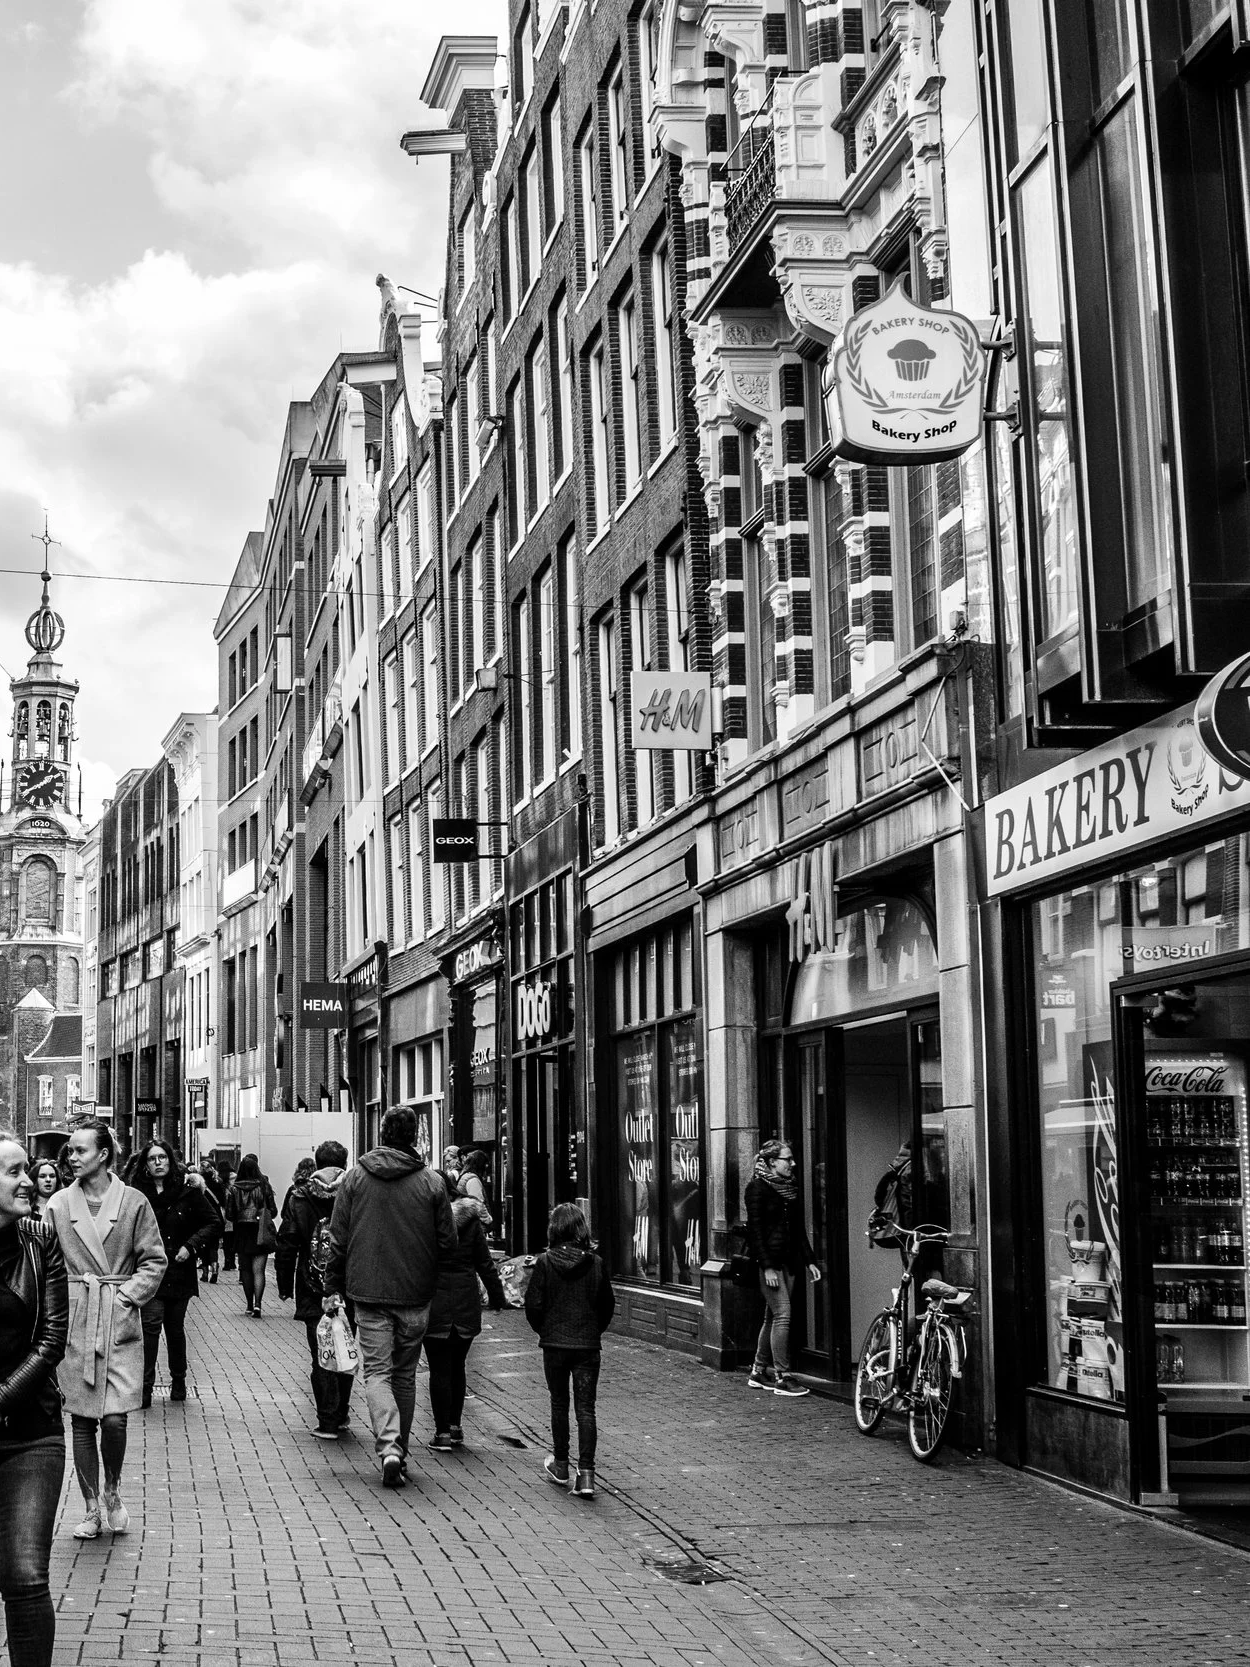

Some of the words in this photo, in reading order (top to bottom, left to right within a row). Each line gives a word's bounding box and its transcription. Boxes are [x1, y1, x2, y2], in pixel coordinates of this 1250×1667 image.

[871, 317, 915, 335] BAKERY
[918, 318, 950, 334] SHOP
[886, 389, 941, 400] Amsterdam
[872, 420, 920, 443] Bakery
[924, 420, 957, 438] Shop
[639, 687, 705, 733] H&M
[993, 742, 1157, 881] BAKERY
[1171, 797, 1193, 816] Bakery
[785, 841, 834, 963] H&M
[303, 999, 342, 1011] HEMA
[518, 982, 550, 1040] DOGO
[1146, 1066, 1228, 1093] Coca-Cola
[626, 1109, 653, 1143] Outlet
[629, 1150, 652, 1182] Store
